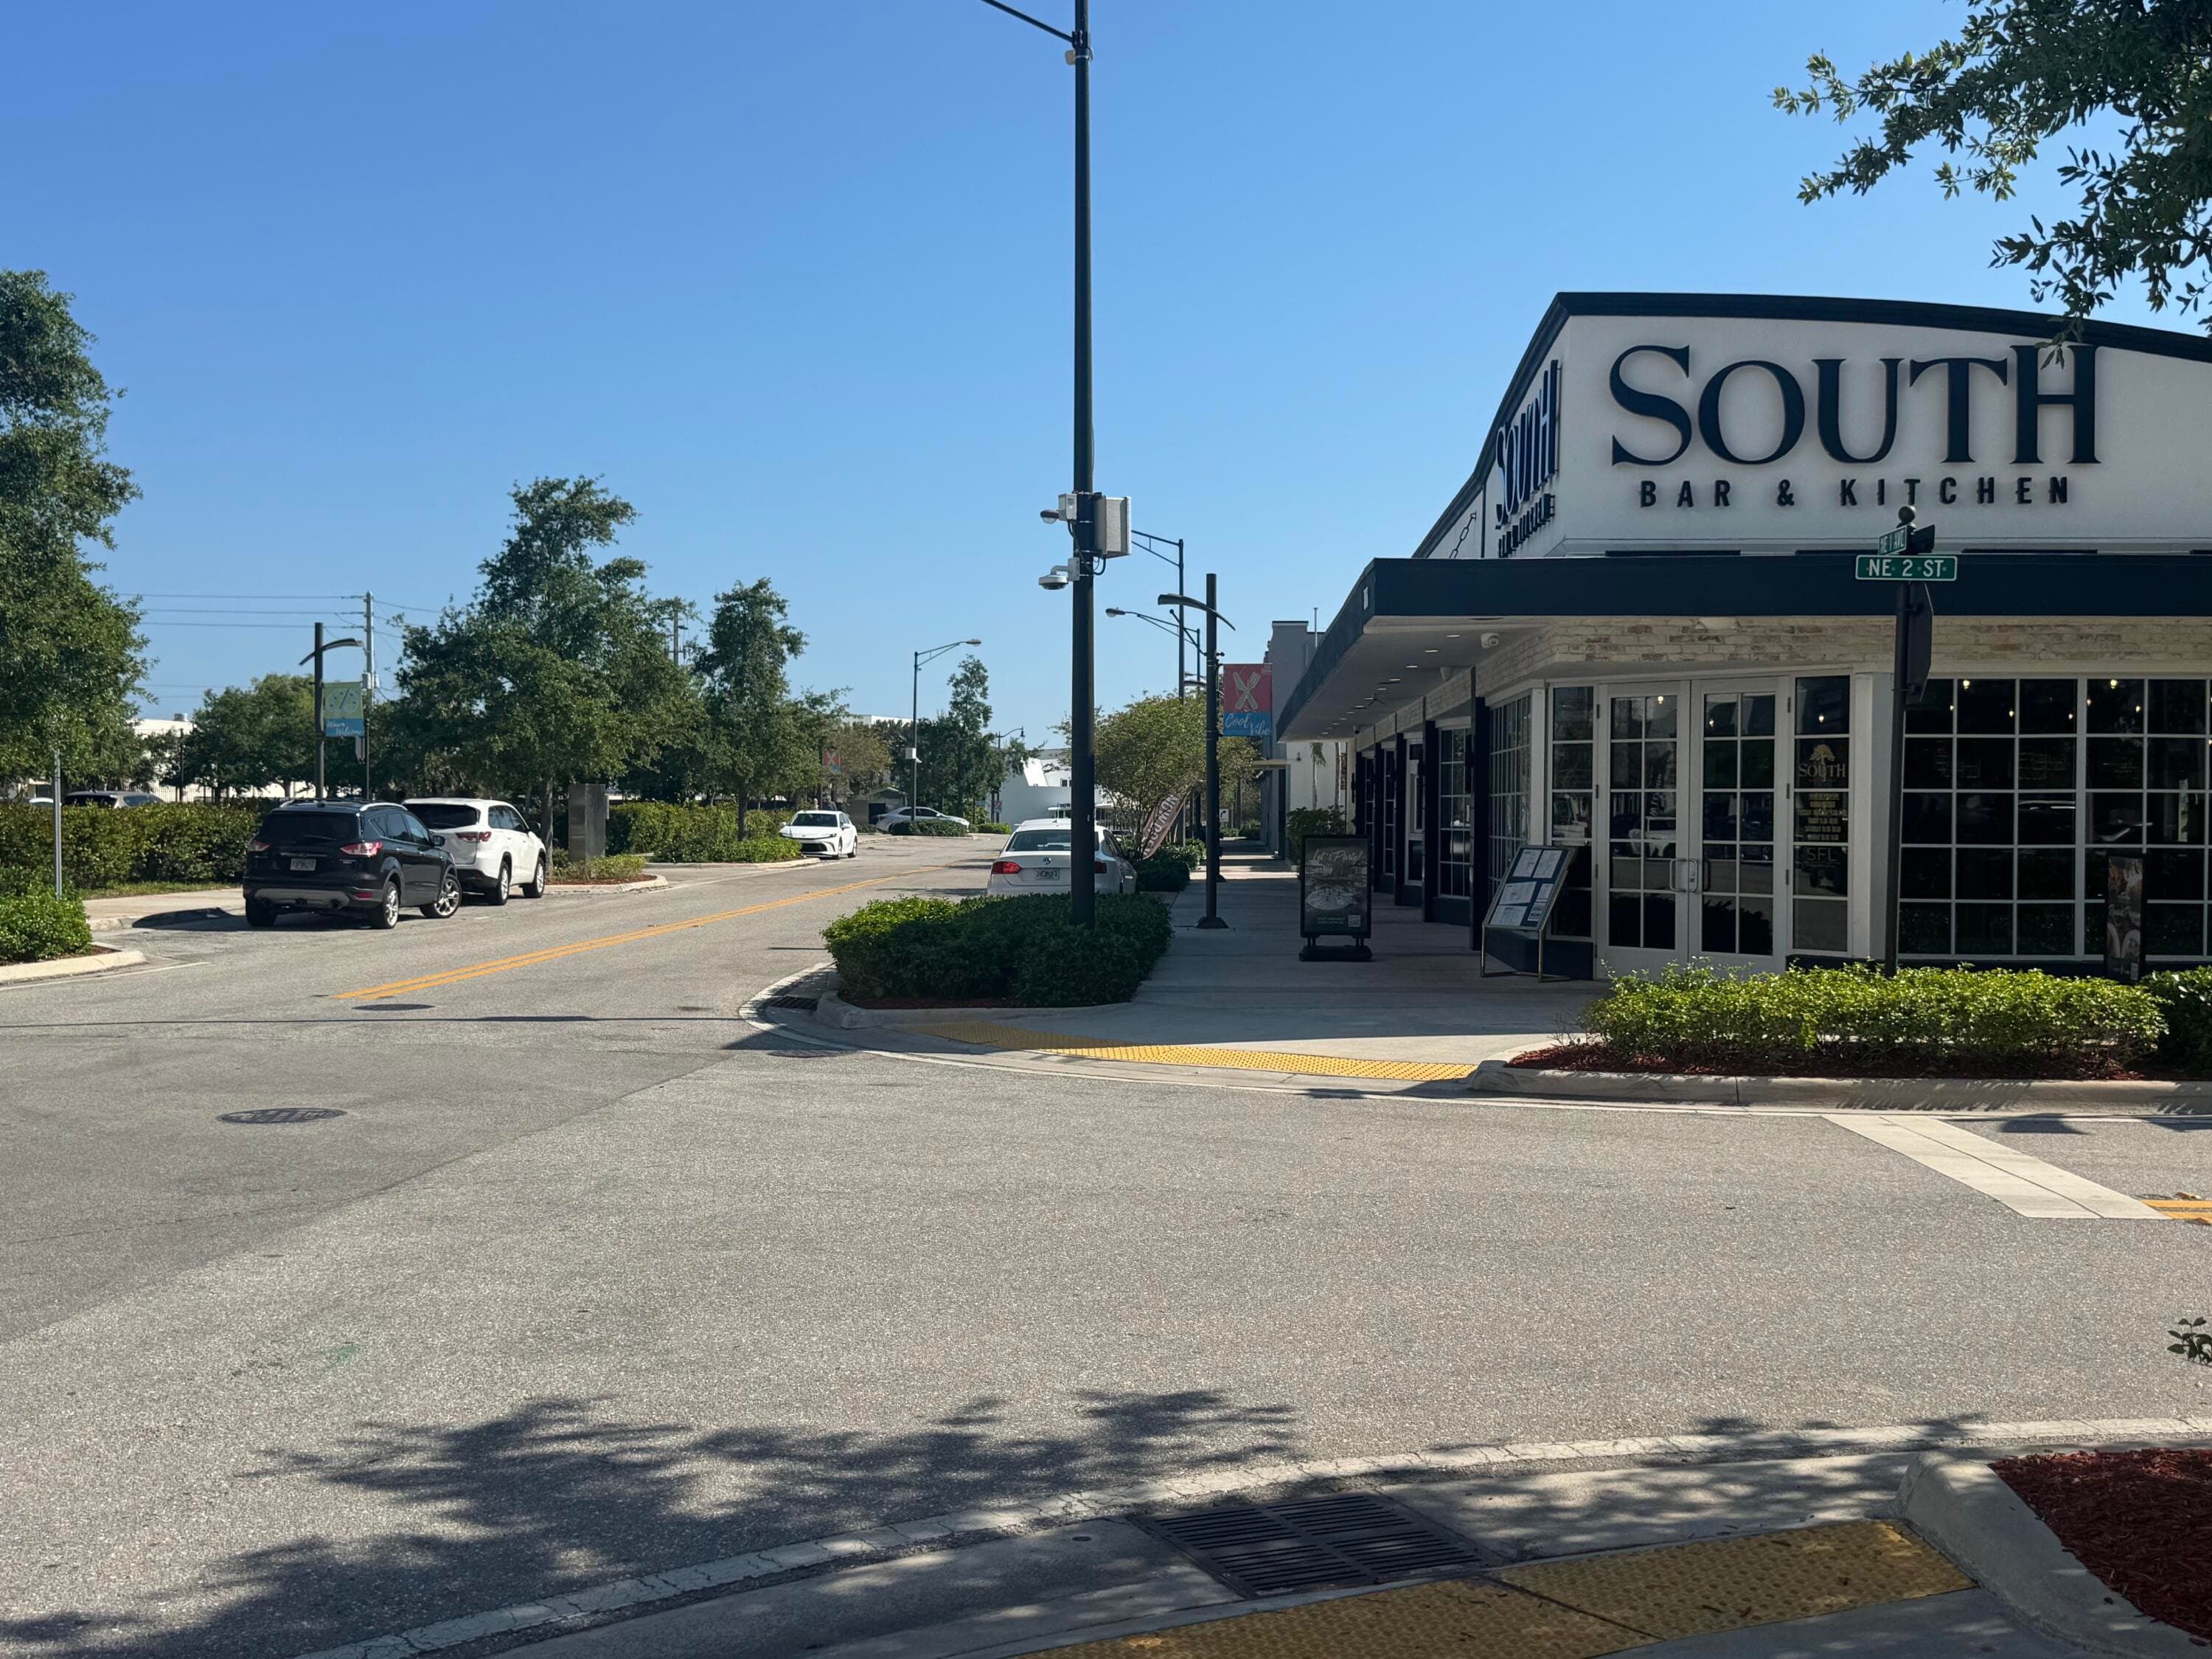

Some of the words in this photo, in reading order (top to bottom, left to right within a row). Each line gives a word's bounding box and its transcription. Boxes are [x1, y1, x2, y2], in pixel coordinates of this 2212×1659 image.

[1609, 344, 2101, 467] SOUTH
[1640, 479, 1731, 508] BAR
[1777, 479, 1795, 507] &
[1840, 476, 2068, 507] KITCHEN
[1893, 530, 1905, 549] AVE
[1868, 559, 1892, 577] NE
[1902, 559, 1913, 577] 2
[1922, 559, 1944, 577] ST
[1225, 713, 1251, 729] Cool
[1798, 762, 1846, 778] SOUTH
[1312, 849, 1332, 861] Let's
[1333, 849, 1363, 865] Party!
[1806, 847, 1837, 861] SFL
